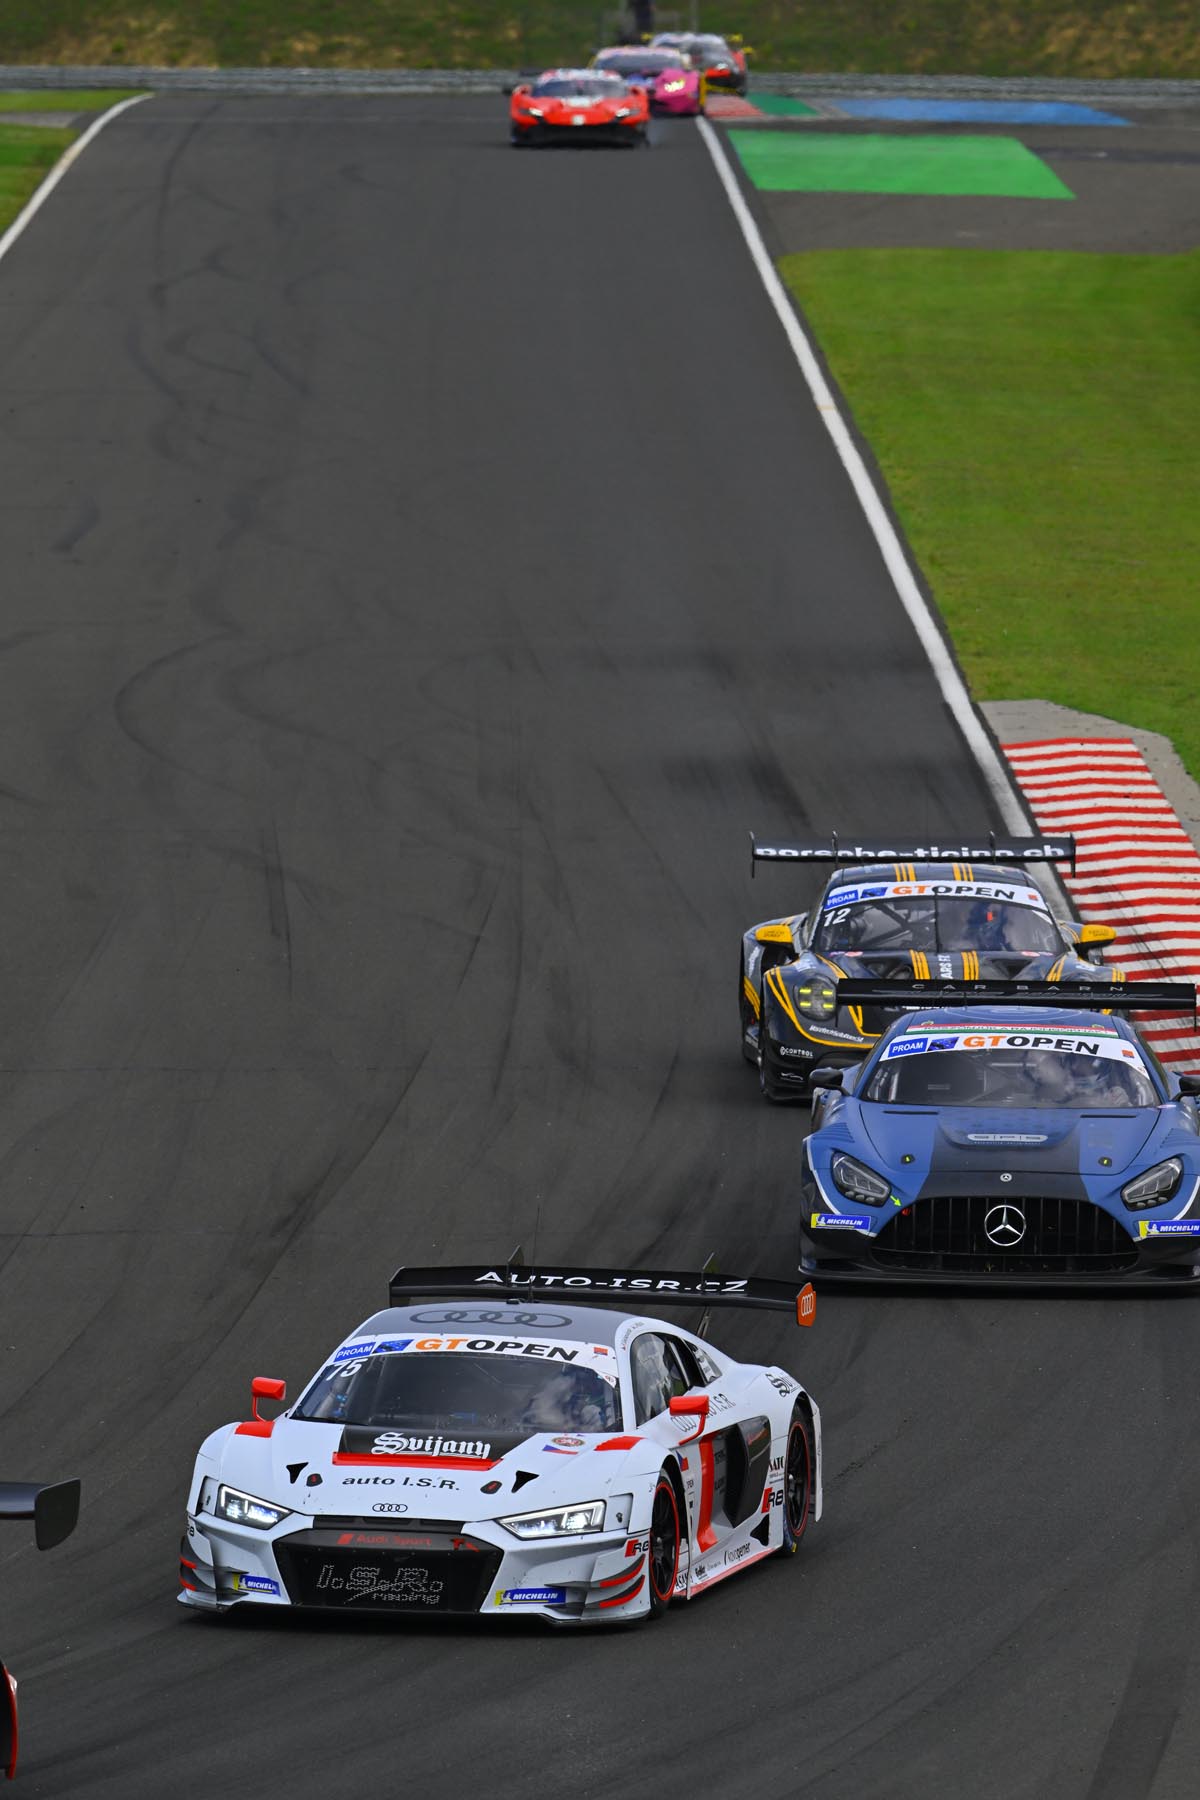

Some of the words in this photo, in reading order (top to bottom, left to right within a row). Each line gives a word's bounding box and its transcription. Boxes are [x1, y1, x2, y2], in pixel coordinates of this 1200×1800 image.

[827, 893, 856, 906] PROAM
[823, 908, 851, 927] 12
[892, 1041, 924, 1053] PROAM
[826, 1218, 863, 1226] MICHELIN
[474, 1271, 748, 1293] AUTO-ISR.CZ
[336, 1345, 373, 1359] PROAM
[326, 1358, 368, 1381] 75
[371, 1432, 491, 1459] Svijany
[342, 1476, 395, 1486] auto
[402, 1477, 460, 1491] I.S.R.
[357, 1534, 389, 1544] Audi
[393, 1535, 432, 1546] Sport
[512, 1592, 559, 1600] MICHELIN
